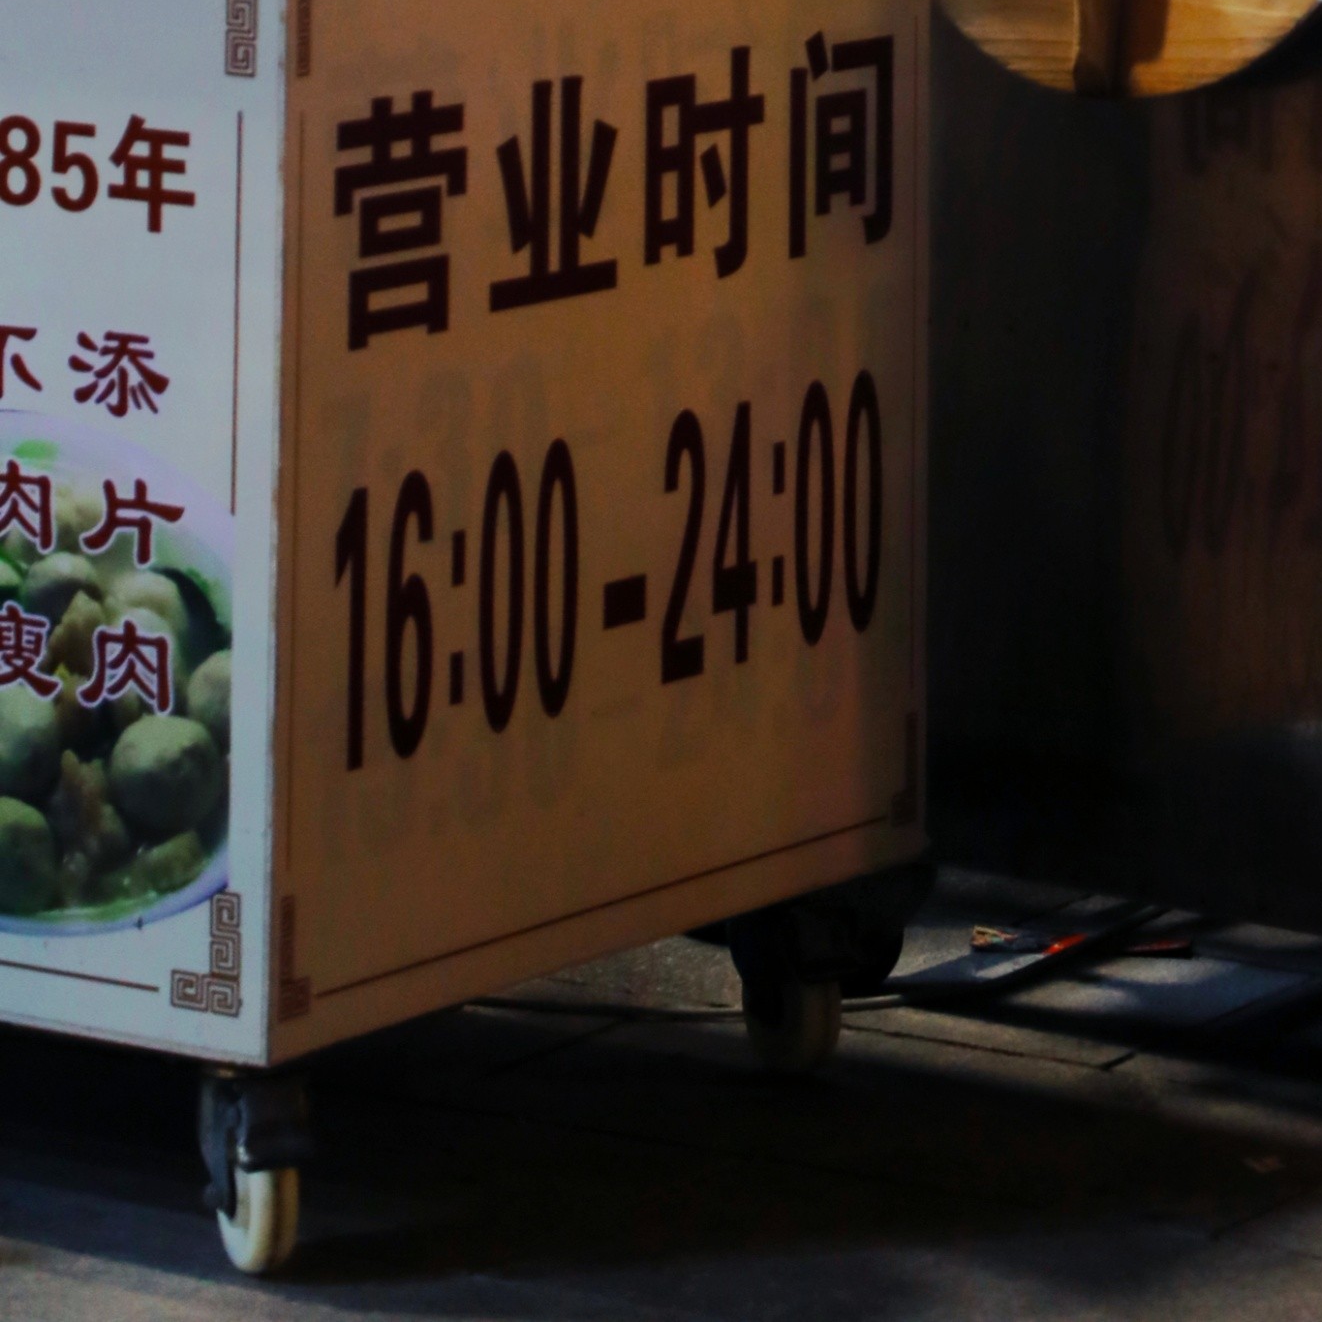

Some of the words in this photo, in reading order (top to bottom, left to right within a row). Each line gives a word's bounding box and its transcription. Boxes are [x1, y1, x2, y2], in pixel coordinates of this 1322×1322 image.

[333, 30, 896, 351] 营业时间
[334, 369, 884, 772] 16:00-24:00
